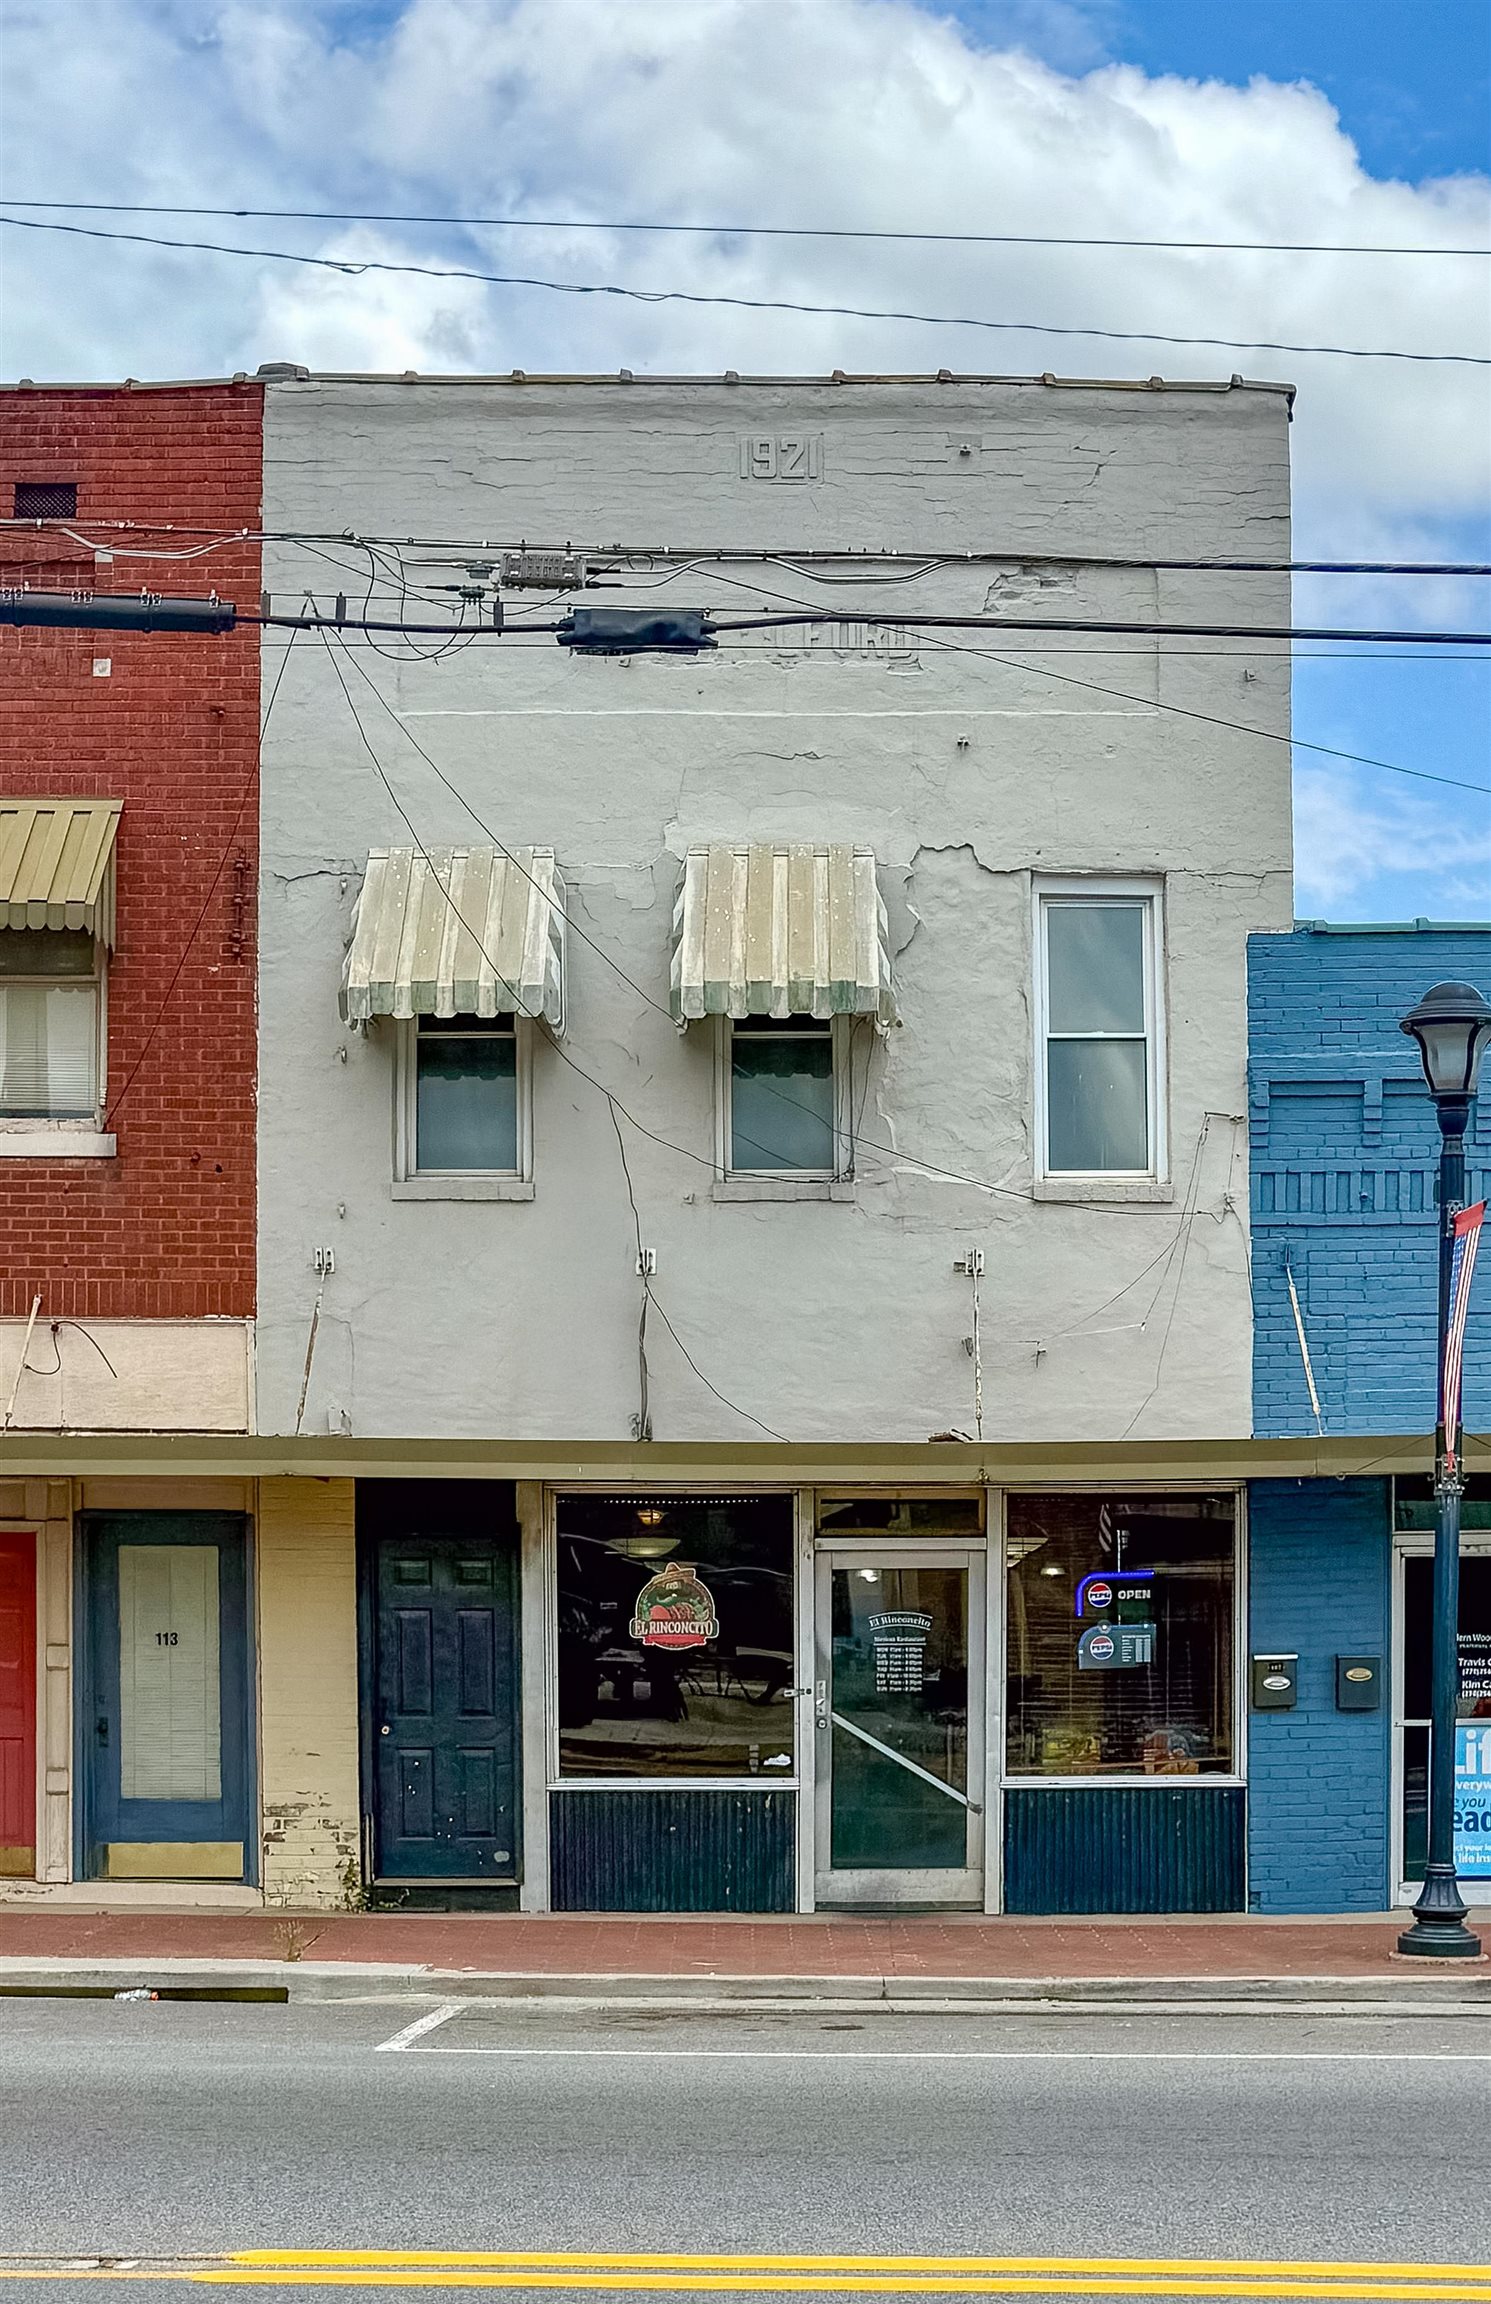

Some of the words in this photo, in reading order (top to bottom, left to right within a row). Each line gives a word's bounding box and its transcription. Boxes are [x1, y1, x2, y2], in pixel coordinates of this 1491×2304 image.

[740, 438, 817, 479] 1921
[1118, 1590, 1151, 1599] OPEN
[634, 1620, 648, 1635] EL
[649, 1620, 713, 1635] RINCONCITO
[155, 1632, 178, 1646] 113
[1458, 1657, 1485, 1667] Travis
[1461, 1798, 1486, 1811] you
